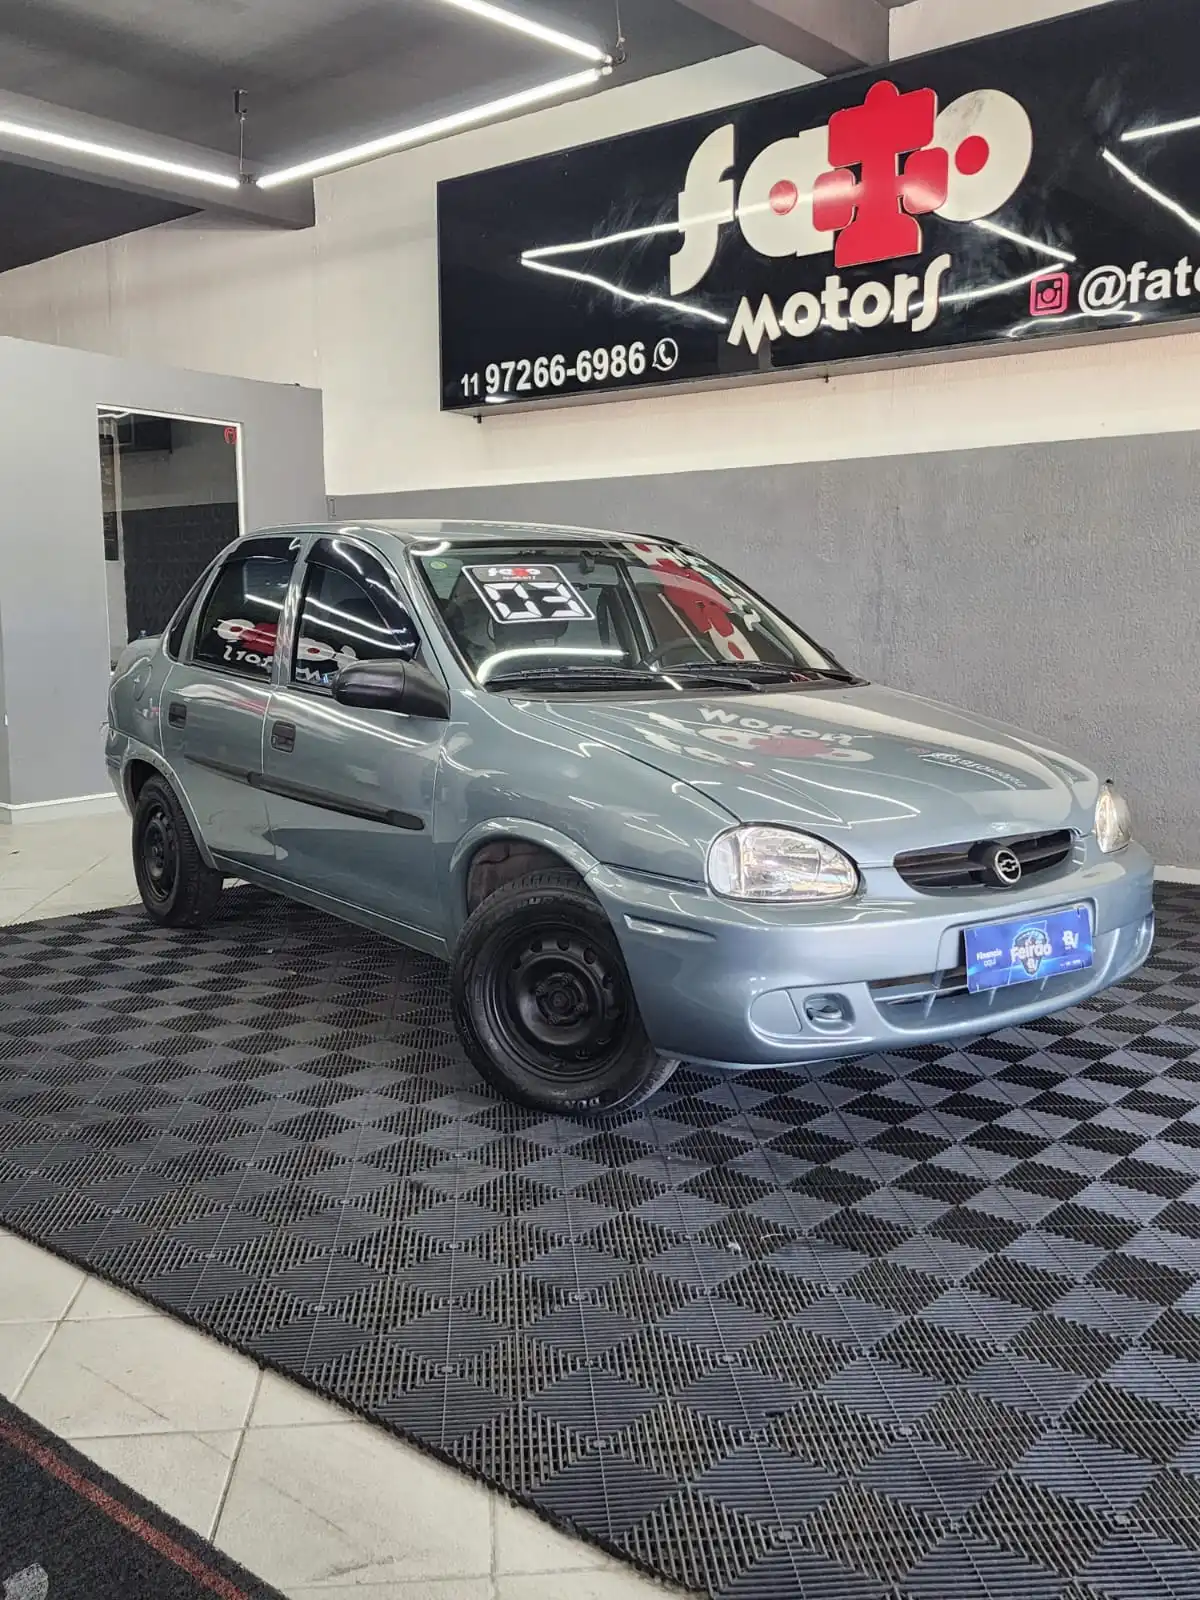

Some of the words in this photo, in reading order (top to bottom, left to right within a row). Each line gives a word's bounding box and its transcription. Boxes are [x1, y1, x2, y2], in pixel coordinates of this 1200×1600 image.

[460, 372, 479, 397] 11
[485, 341, 646, 394] 97266-6986
[483, 582, 586, 619] 03
